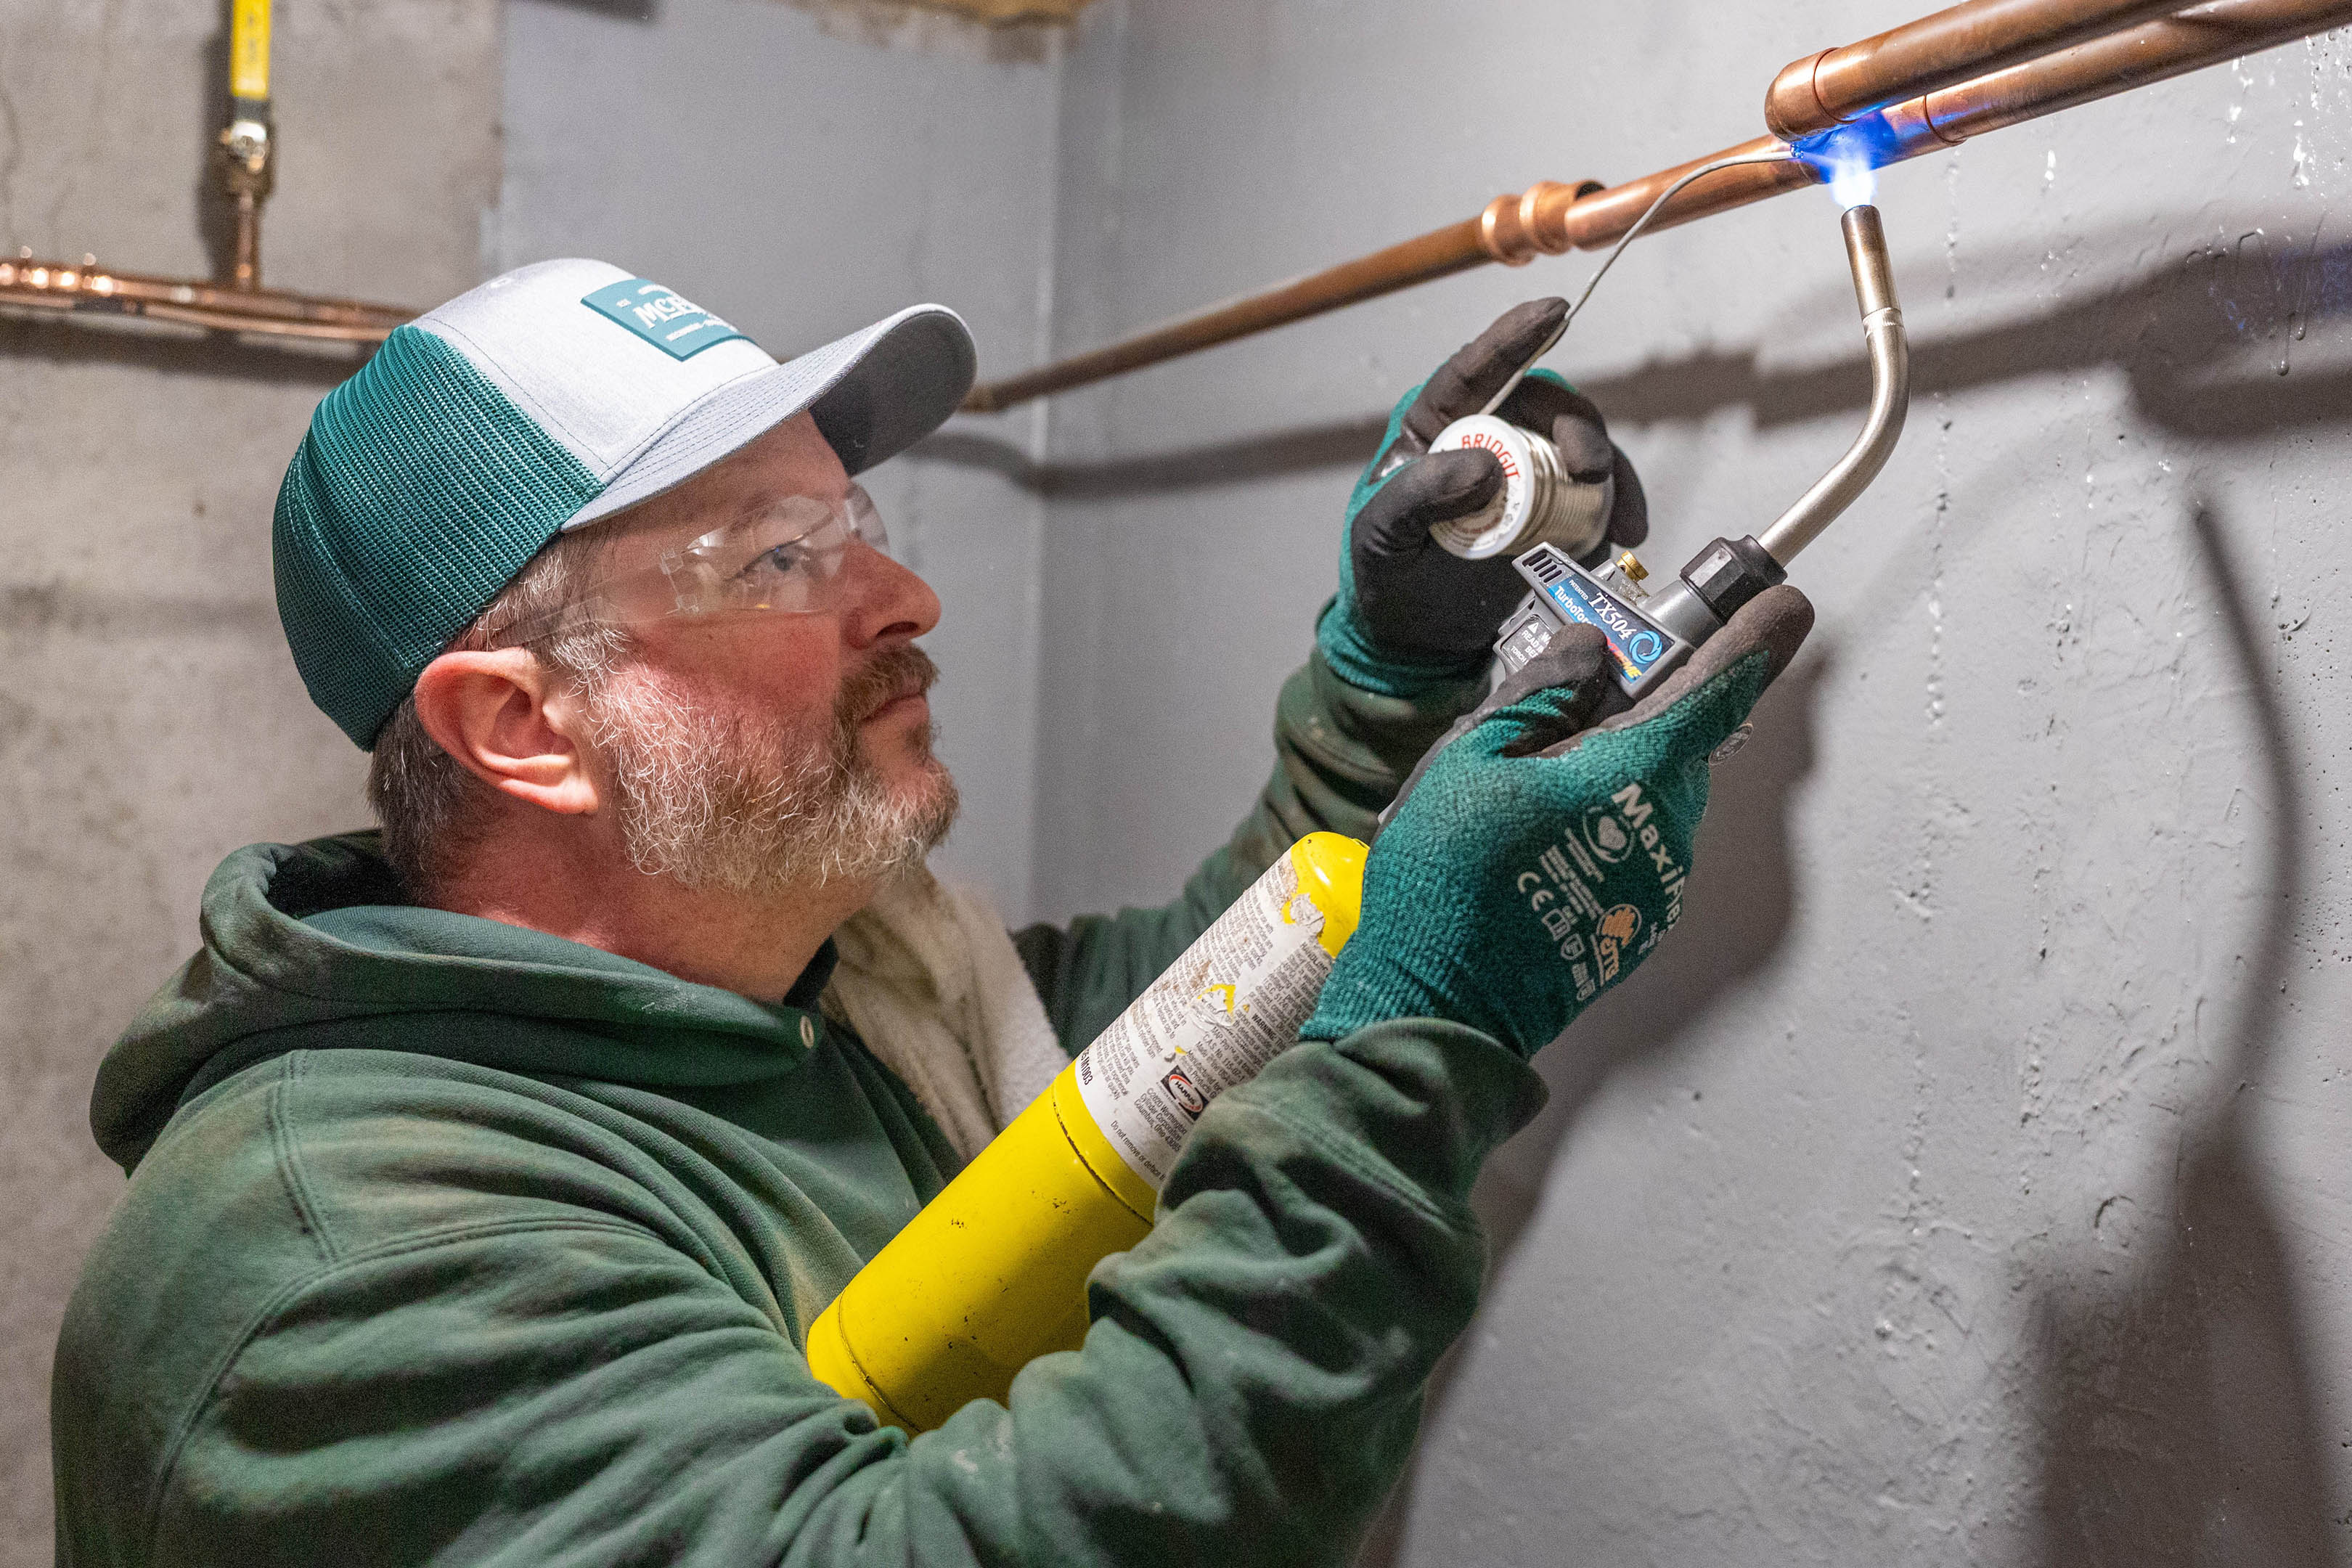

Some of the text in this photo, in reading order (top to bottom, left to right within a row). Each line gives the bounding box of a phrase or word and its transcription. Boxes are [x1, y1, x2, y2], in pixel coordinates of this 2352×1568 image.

[1461, 433, 1520, 481] BRIDGIT
[1568, 579, 1588, 601] PATENTED
[1552, 584, 1597, 632] TurboTor
[1586, 589, 1637, 643] TX504
[1519, 629, 1540, 648] READ
[1508, 645, 1527, 663] TORCH
[1517, 872, 1555, 912] CE
[1264, 920, 1274, 934] with
[1249, 947, 1264, 967] sparks,
[1264, 938, 1273, 950] are
[1241, 951, 1257, 972] tighten
[1169, 1017, 1180, 1029] and
[1175, 1010, 1184, 1021] not
[1180, 1018, 1187, 1026] in
[1233, 1008, 1251, 1028] carbon
[1251, 1012, 1278, 1042] WARNING:
[1162, 1023, 1172, 1034] cap
[1168, 1031, 1176, 1040] to
[1146, 1045, 1156, 1059] burn
[1077, 1055, 1096, 1086] M1003
[1213, 1048, 1226, 1061] No.
[1221, 1056, 1246, 1083] 115-07-1
[1217, 1067, 1232, 1083] USA
[1108, 1069, 1130, 1097] experience
[1174, 1080, 1196, 1106] HARRIS
[1189, 1069, 1212, 1095] Products
[1131, 1098, 1159, 1127] Columbus,
[1152, 1122, 1168, 1139] Ohio
[1138, 1092, 1159, 1115] Cylinder
[1153, 1111, 1183, 1143] Corporation
[1158, 1103, 1188, 1137] Worthington
[1109, 1119, 1161, 1179] Do not remove or deface
